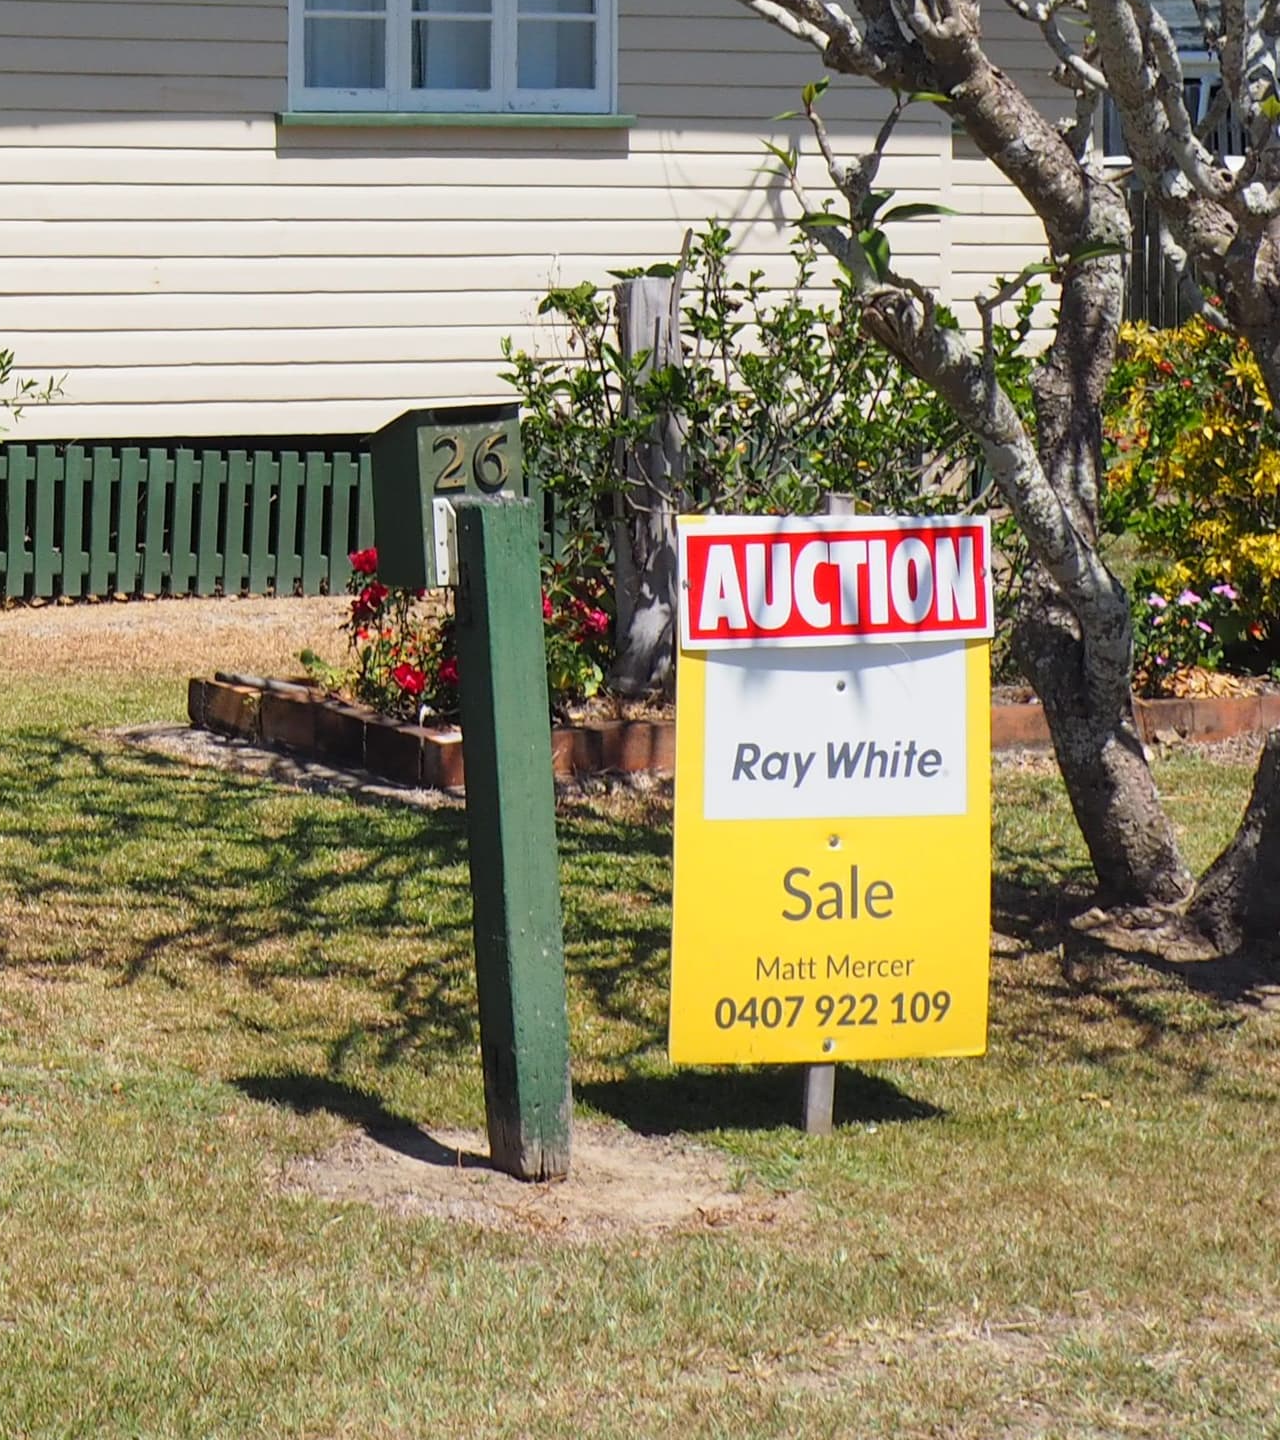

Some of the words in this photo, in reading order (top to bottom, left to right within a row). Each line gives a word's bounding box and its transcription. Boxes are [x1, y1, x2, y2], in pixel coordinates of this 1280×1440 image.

[432, 432, 509, 492] 26
[698, 536, 977, 631] AUCTION
[732, 742, 816, 788] Ray
[826, 740, 942, 779] White
[782, 864, 894, 921] Sale
[756, 955, 817, 981] Matt
[826, 954, 915, 979] Mercer
[714, 995, 804, 1029] 0407
[815, 993, 878, 1027] 922
[890, 990, 951, 1024] 109
